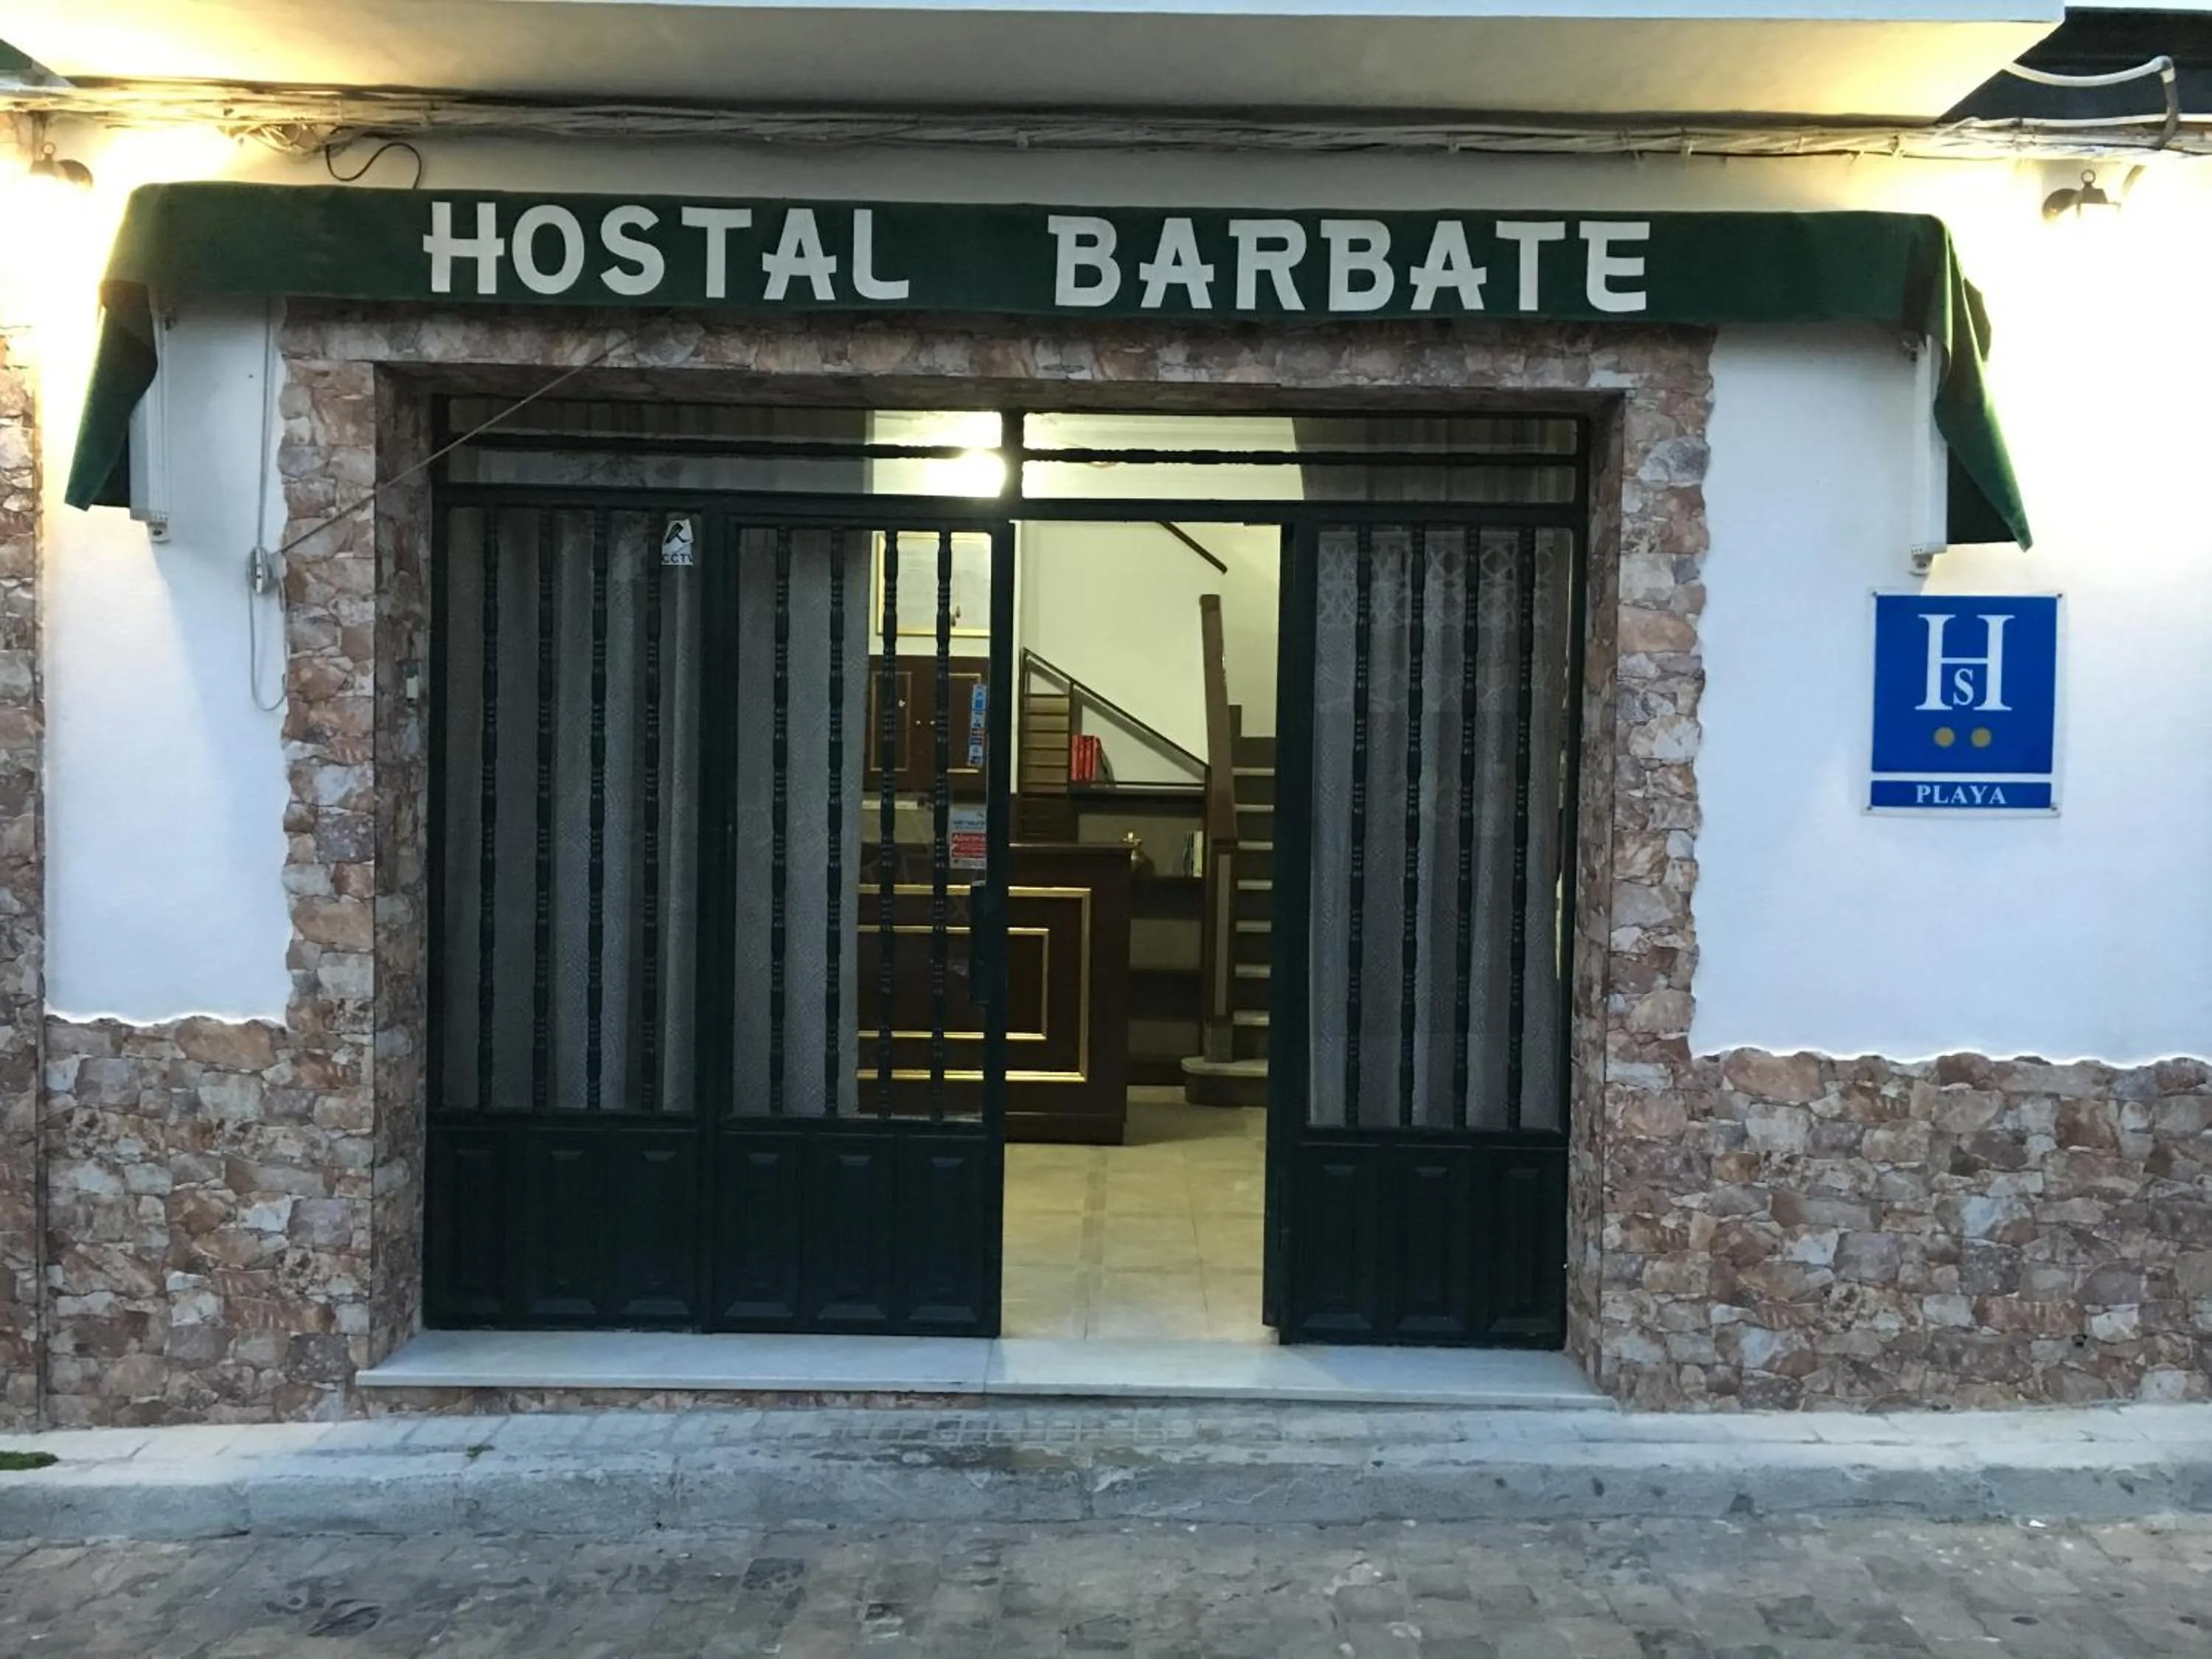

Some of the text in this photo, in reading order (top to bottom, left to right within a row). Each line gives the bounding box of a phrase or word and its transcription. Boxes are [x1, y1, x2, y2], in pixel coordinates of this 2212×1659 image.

[423, 201, 1650, 313] HOSTAL BARBATE
[1917, 785, 2006, 804] PLAYA
